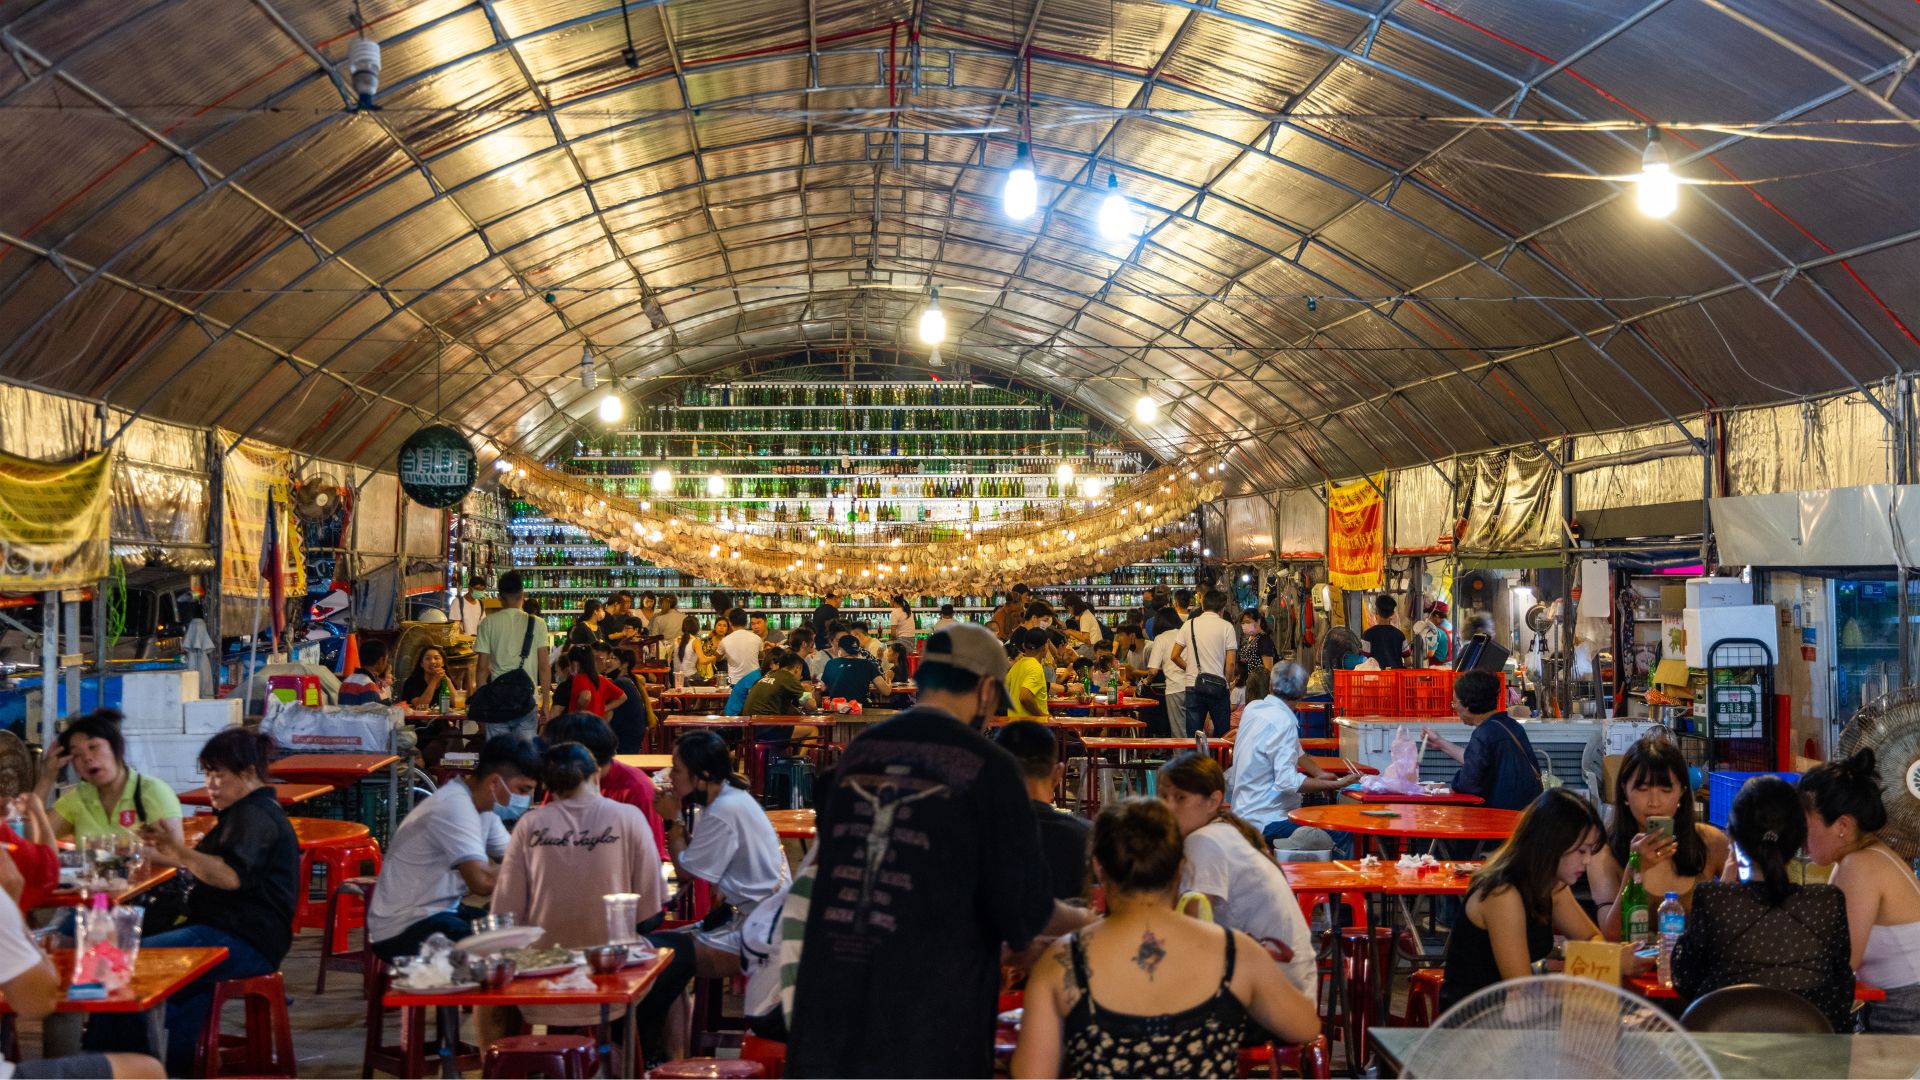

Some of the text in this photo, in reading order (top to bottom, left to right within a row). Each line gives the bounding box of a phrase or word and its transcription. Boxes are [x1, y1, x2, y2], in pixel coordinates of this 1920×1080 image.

[402, 447, 473, 474] 台灣啤酒
[403, 473, 467, 484] TAIWAN BEER
[529, 826, 620, 851] Chuck Taylor
